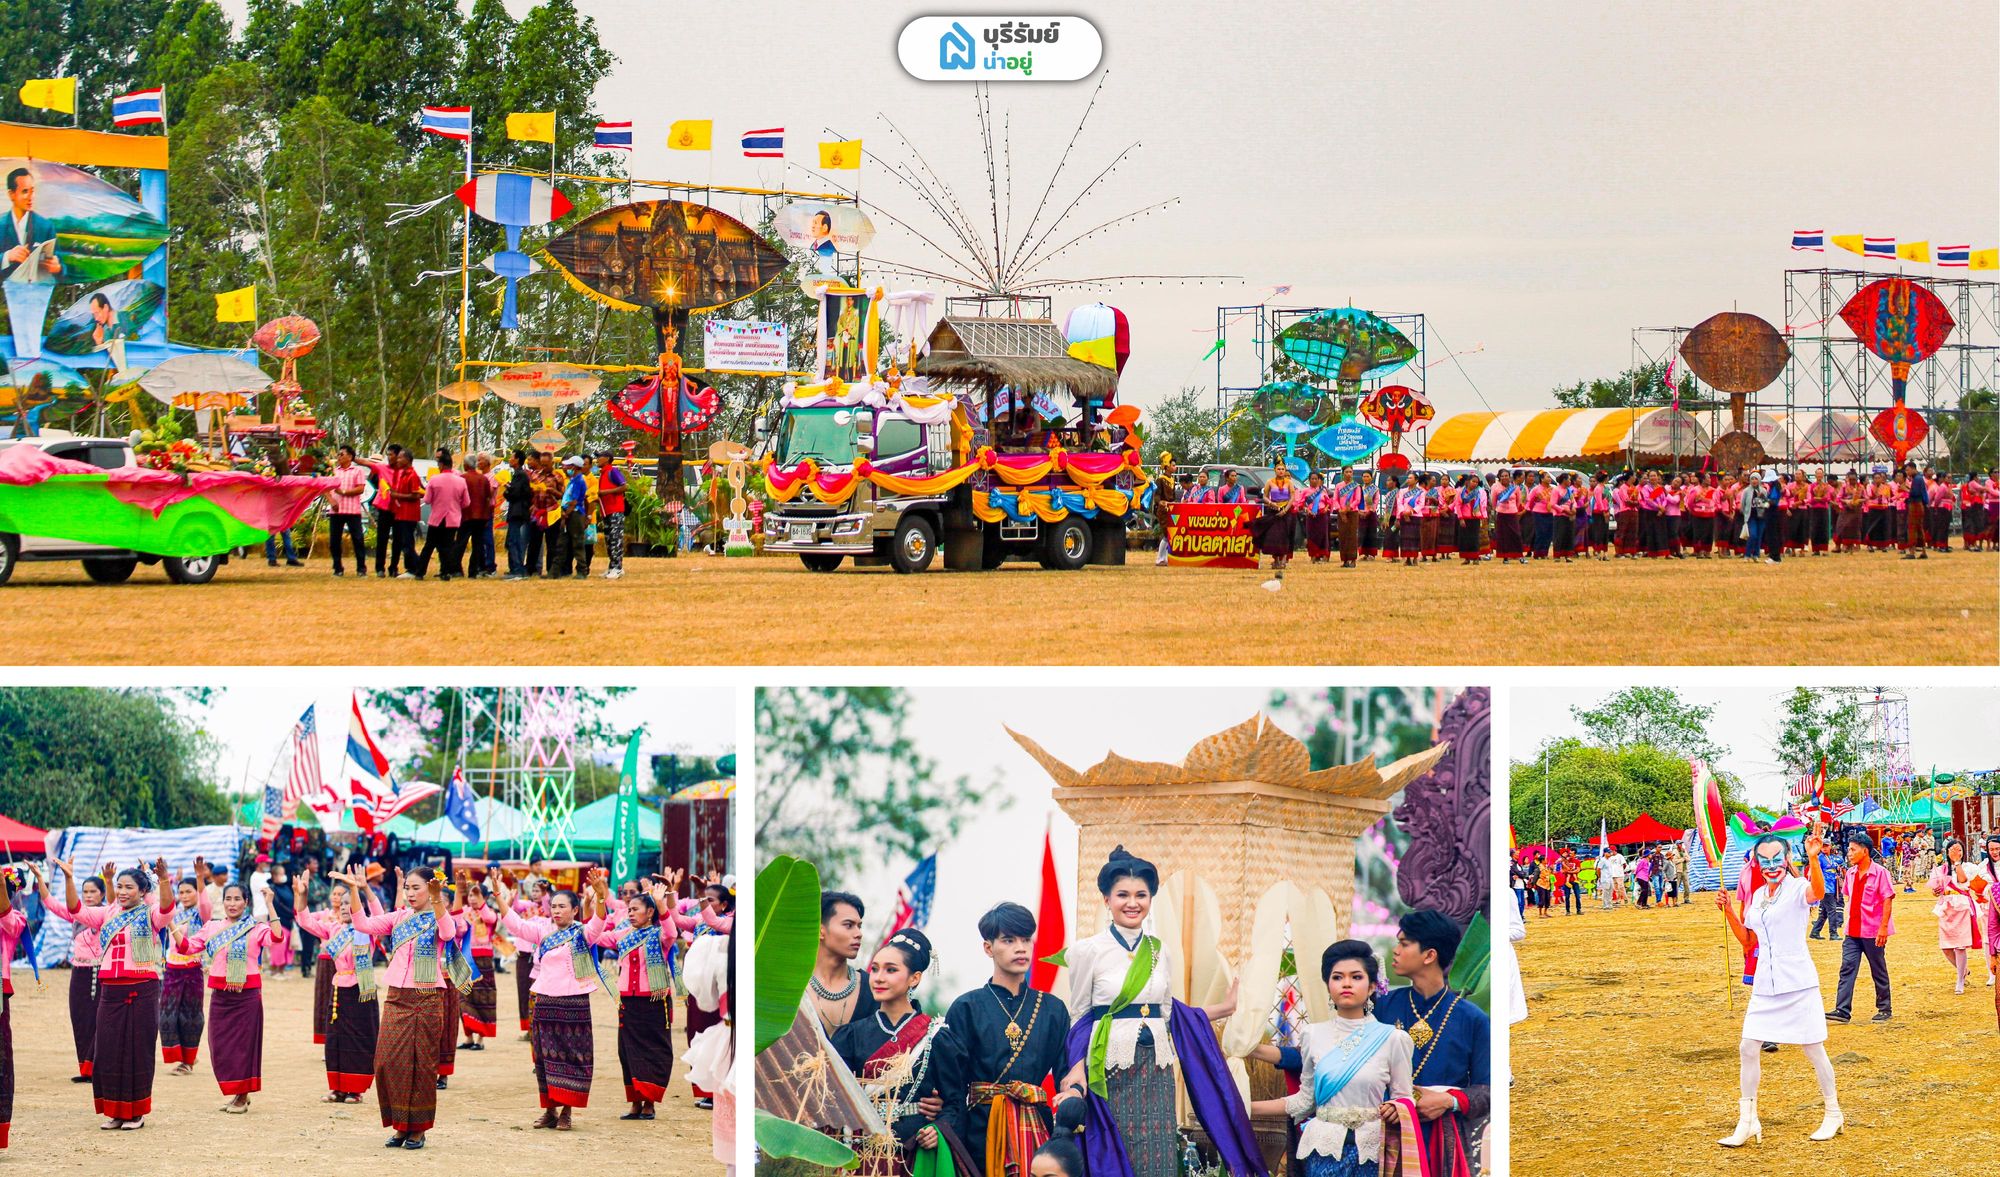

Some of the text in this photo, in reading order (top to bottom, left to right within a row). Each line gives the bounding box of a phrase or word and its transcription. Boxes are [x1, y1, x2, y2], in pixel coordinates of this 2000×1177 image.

[1188, 511, 1229, 528] ขบวนว่าว
[1172, 527, 1254, 554] ตำบลตาเสา
